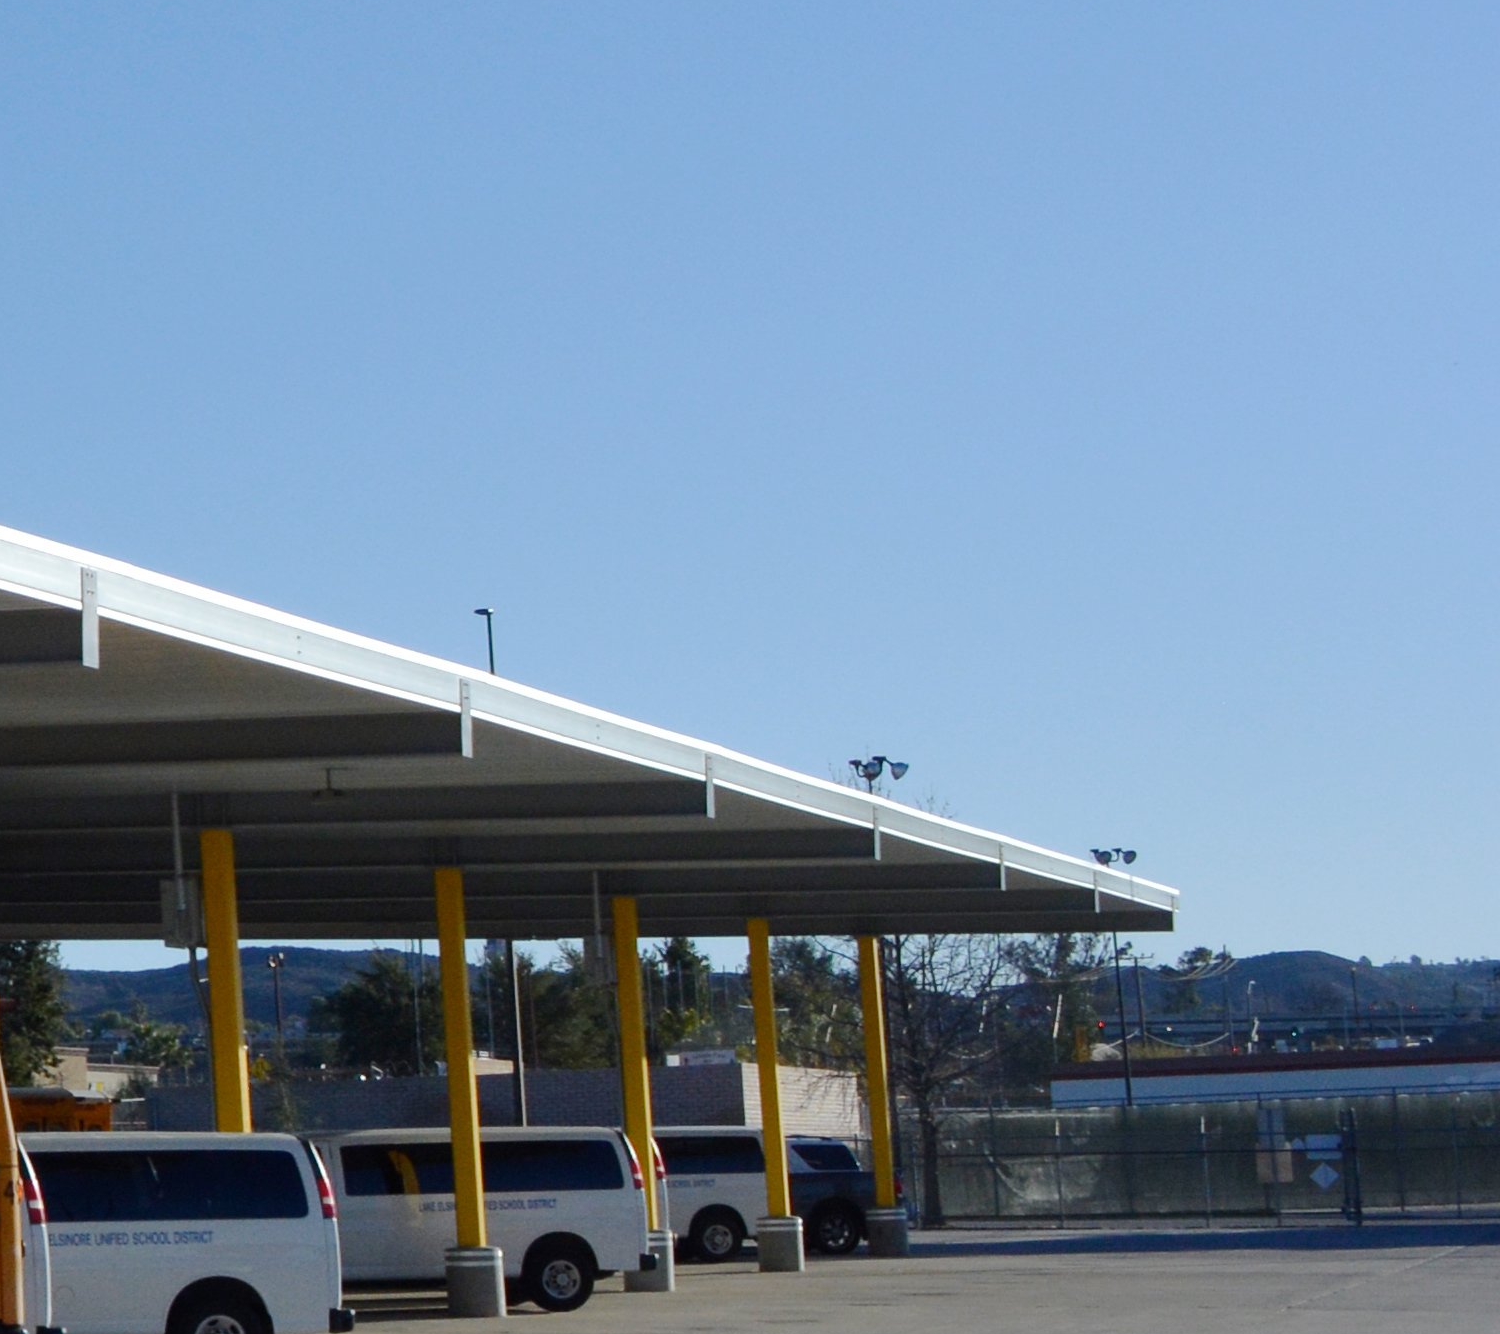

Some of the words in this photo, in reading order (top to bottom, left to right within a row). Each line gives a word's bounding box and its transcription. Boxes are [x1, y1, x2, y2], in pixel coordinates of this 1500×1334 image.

[49, 1232, 92, 1247] ELSINORE
[94, 1232, 130, 1246] UNIFIED
[132, 1231, 172, 1246] SCHOOL
[173, 1229, 214, 1245] DISTRICT
